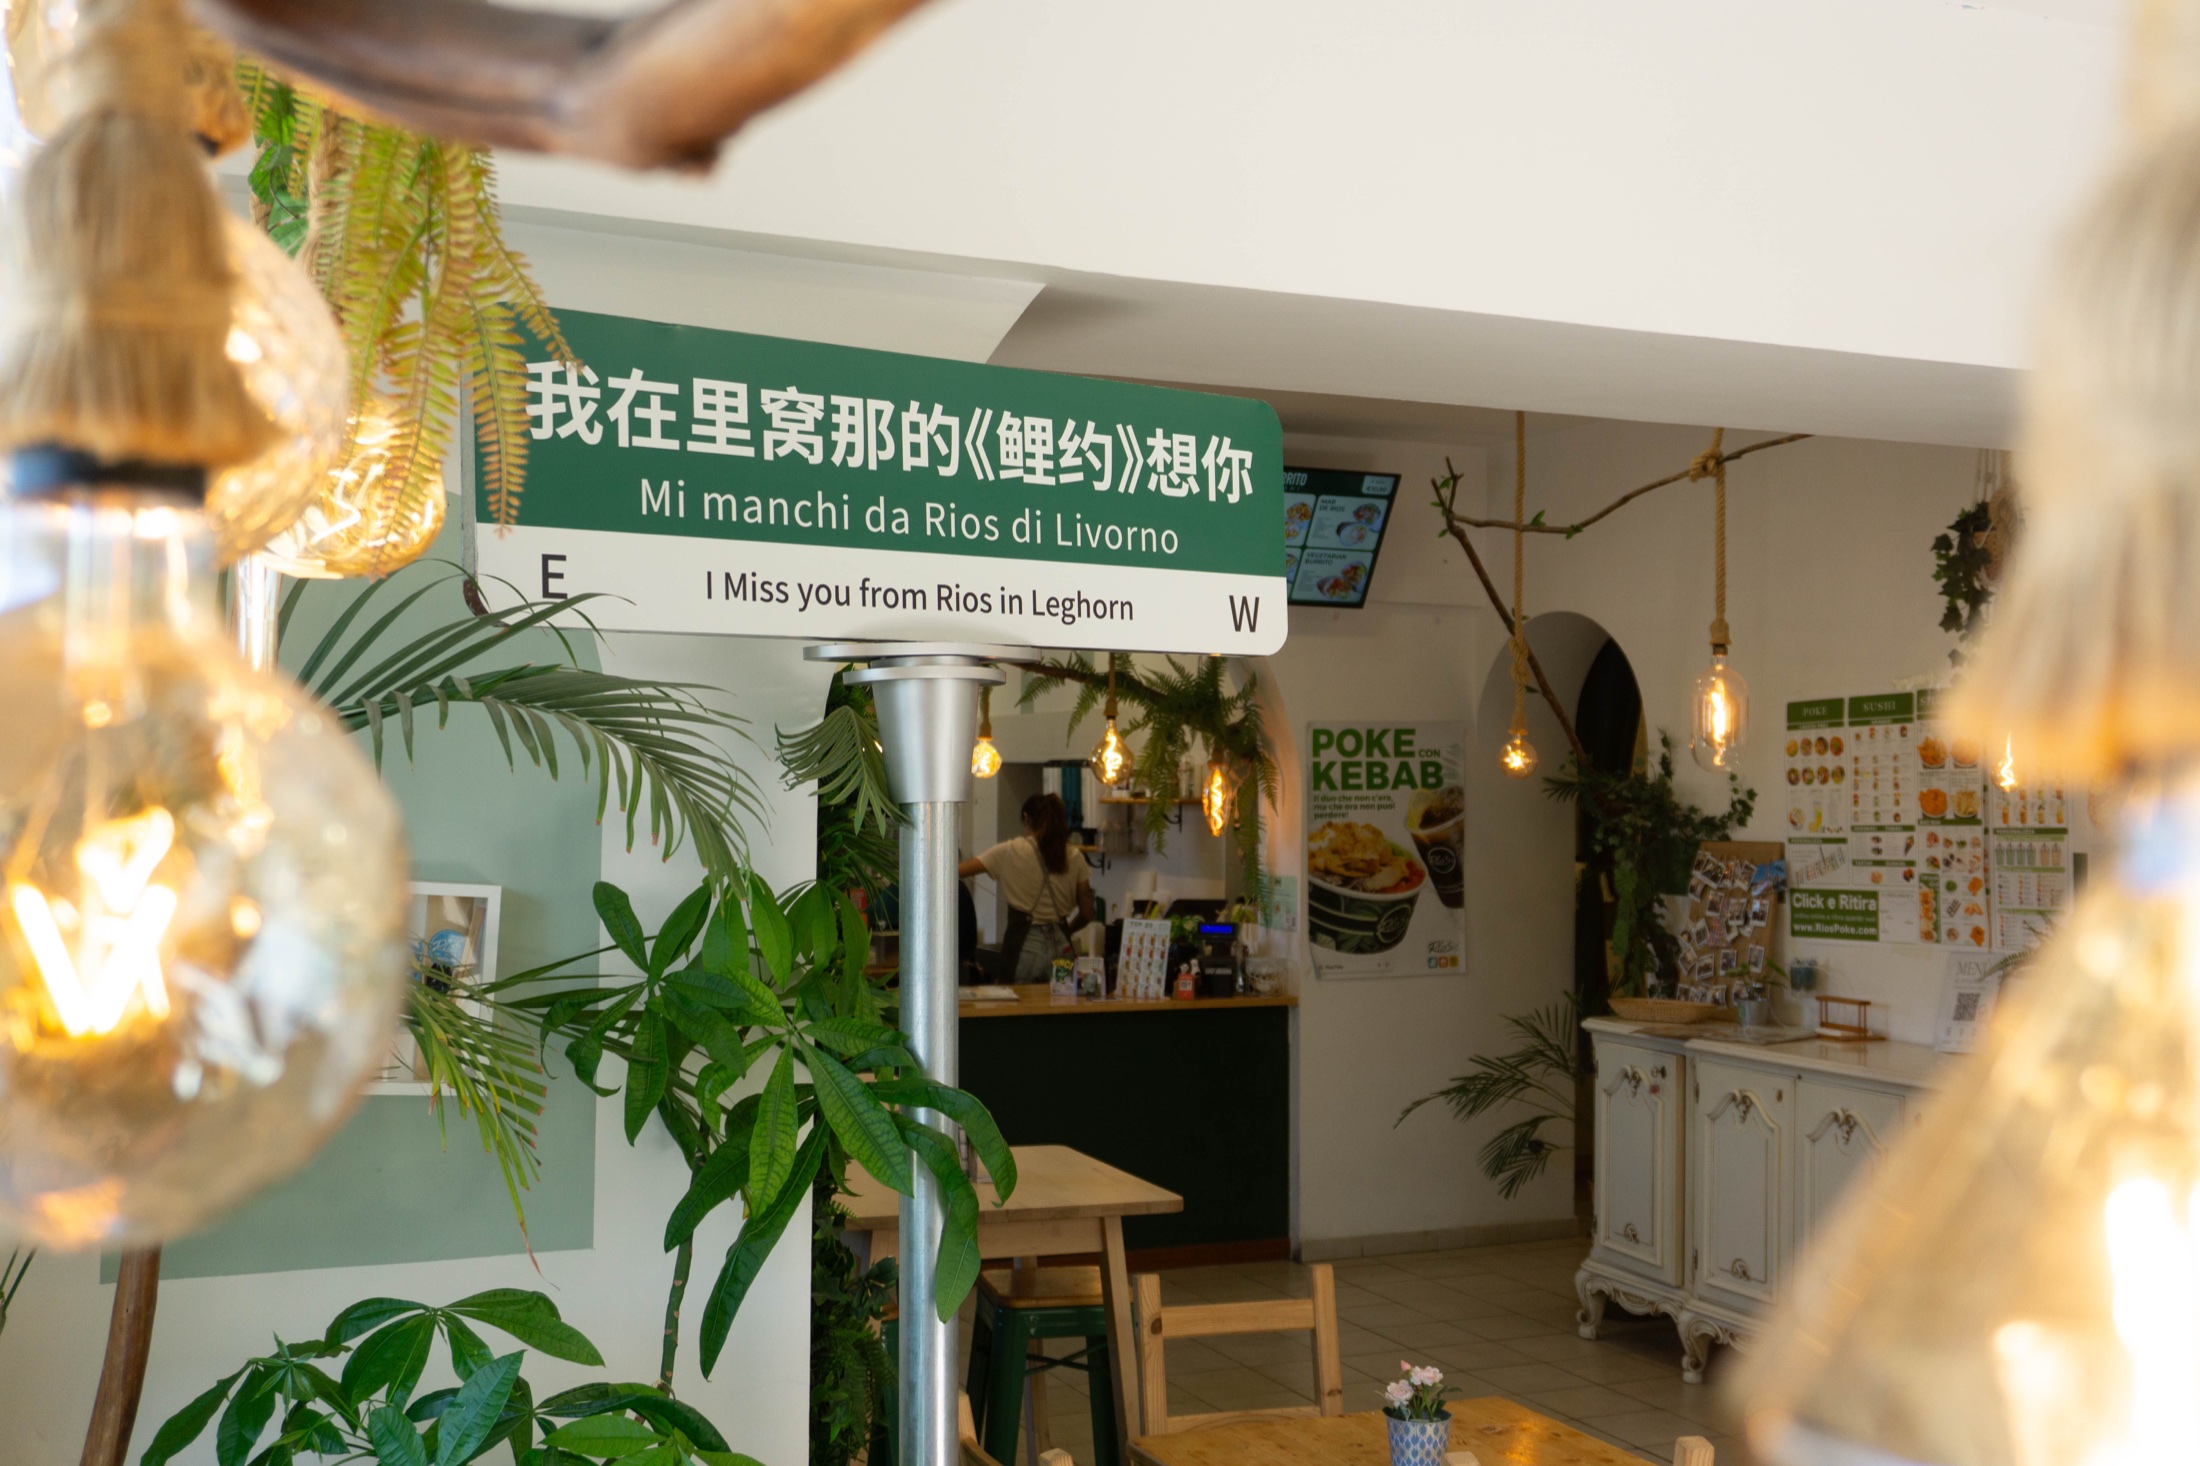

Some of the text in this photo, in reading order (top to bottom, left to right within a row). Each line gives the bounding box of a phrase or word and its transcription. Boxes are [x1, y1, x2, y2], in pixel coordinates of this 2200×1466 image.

[525, 360, 1253, 503] 我在里窝那的《鲤约》想你
[641, 478, 1179, 554] Mi manchi da Rios di Livorno
[541, 553, 568, 600] E
[706, 570, 1134, 625] I Miss you from Rios in Leghorn
[1229, 595, 1260, 633] W
[1803, 706, 1828, 717] POKE
[1863, 700, 1896, 712] SUSHI
[1313, 728, 1440, 758] POKE CON
[1313, 761, 1443, 791] KEBAB
[1321, 794, 1336, 802] duo
[1338, 794, 1352, 802] che
[1329, 802, 1343, 811] che
[1345, 803, 1358, 811] ora
[1360, 803, 1376, 811] non
[1378, 801, 1396, 812] puoi
[1314, 811, 1349, 820] perdere!
[1792, 892, 1877, 911] Click e Ritira
[1794, 922, 1878, 936] www.RiosPoke.com
